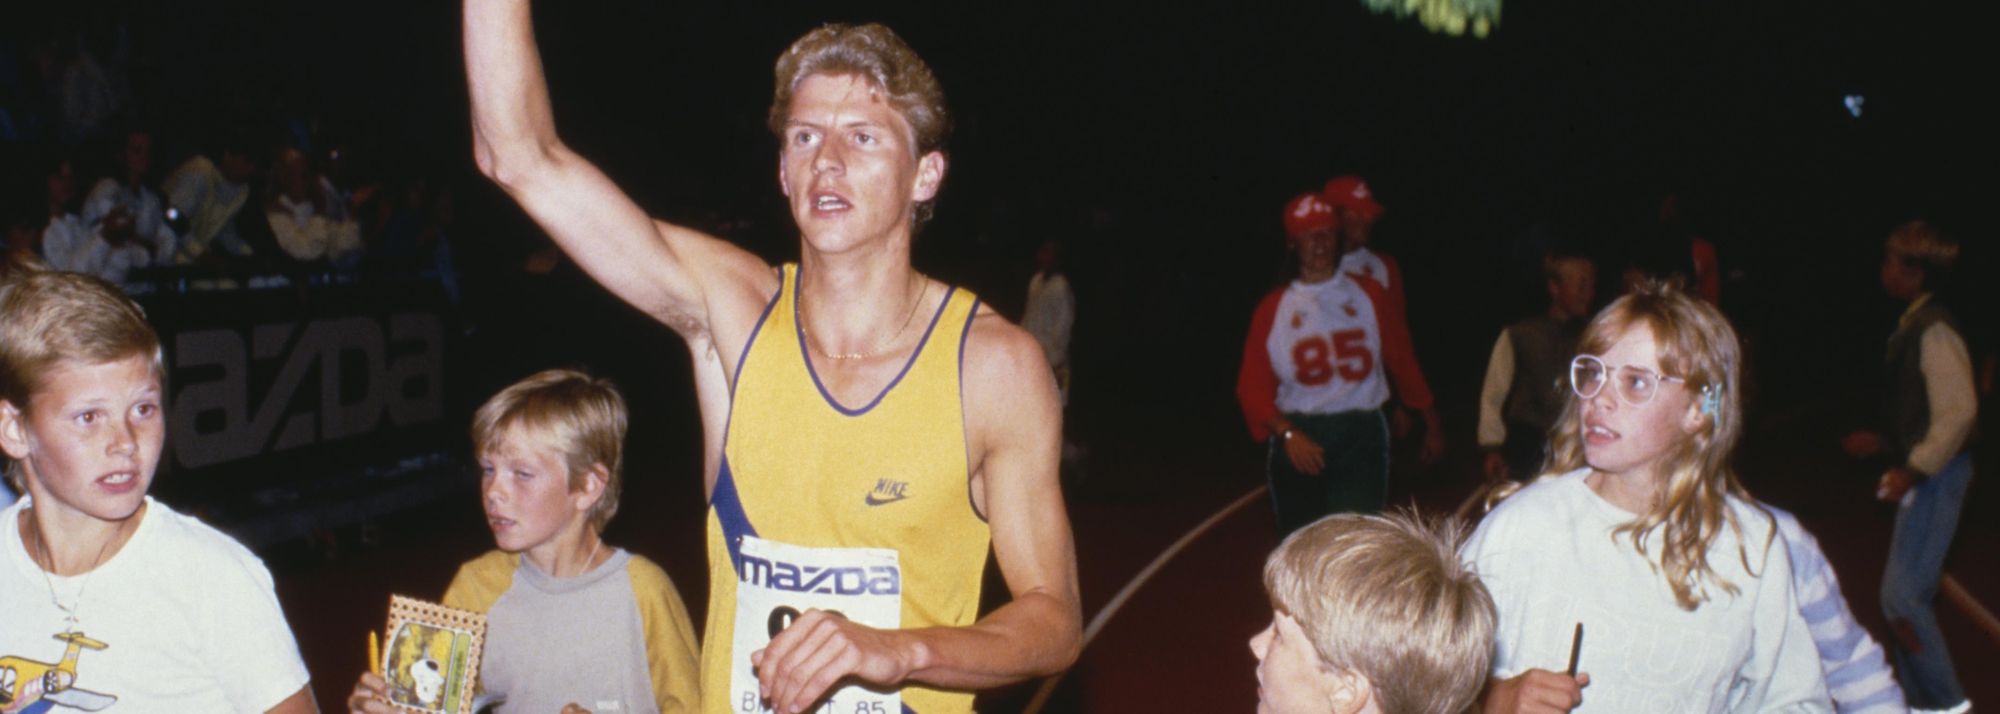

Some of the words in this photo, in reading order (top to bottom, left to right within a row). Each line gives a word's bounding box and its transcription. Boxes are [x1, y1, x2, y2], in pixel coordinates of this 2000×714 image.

[1292, 328, 1374, 387] 85
[166, 312, 444, 470] azda
[873, 478, 909, 497] NIKE
[855, 700, 886, 714] 85
